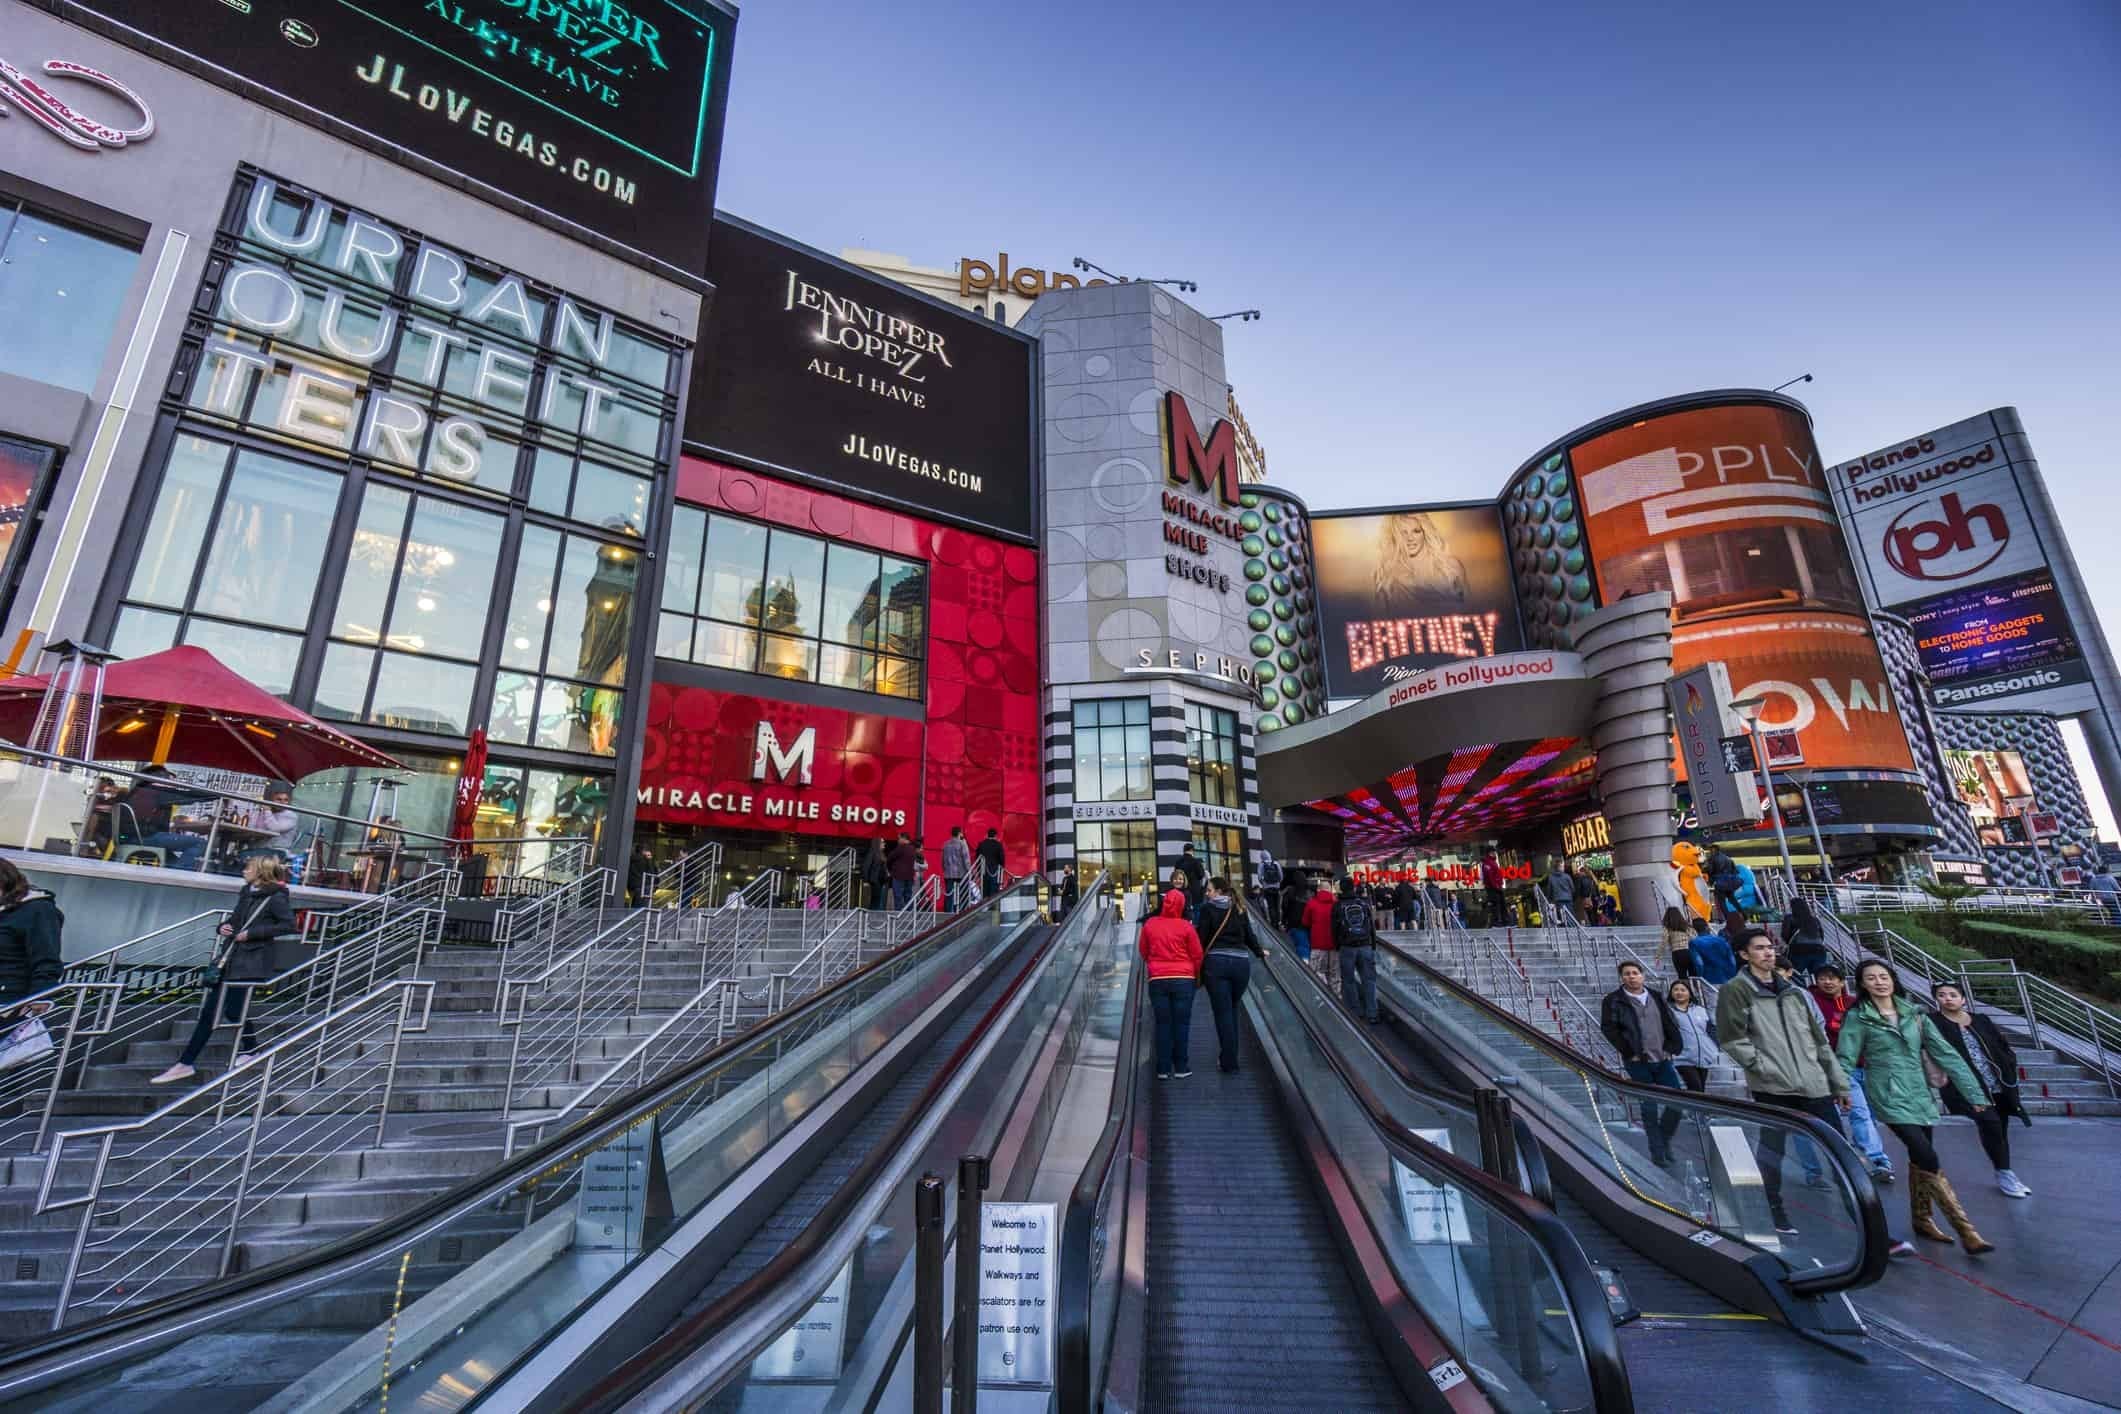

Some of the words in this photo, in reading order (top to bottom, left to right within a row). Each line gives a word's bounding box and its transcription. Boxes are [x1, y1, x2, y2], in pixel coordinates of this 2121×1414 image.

[528, 47, 621, 108] HAVE
[248, 177, 614, 364] URBAN
[784, 270, 952, 368] JENNIFER
[222, 261, 619, 434] OUTFIT
[820, 308, 926, 383] LOPEZ
[808, 357, 851, 383] ALL
[871, 378, 926, 408] HAVE
[202, 338, 487, 482] TERS
[1164, 391, 1240, 506] M
[1848, 437, 1936, 483] planet
[1853, 444, 1995, 504] hollywood
[1162, 491, 1245, 541] MIRACLE
[1164, 521, 1208, 555] MILE
[1166, 553, 1230, 593] SHOPS
[1345, 611, 1499, 673] BRITNEY
[1919, 627, 1987, 649] ELECTRONIC
[1990, 613, 2044, 634] GADGETS
[1952, 637, 1985, 651] HOME
[1987, 627, 2028, 643] GOODS
[1964, 618, 1989, 630] FROM
[1389, 677, 1437, 708] planet
[1445, 658, 1554, 689] hollywood
[1933, 669, 2061, 704] Panasonic
[753, 720, 816, 785] M
[636, 787, 752, 813] MIRACLE
[765, 798, 819, 819] MILE
[831, 803, 906, 826] SHOPS
[1563, 816, 1611, 855] CABAR
[992, 1220, 1026, 1228] Welcome
[985, 1270, 1023, 1280] Walkways
[1025, 1271, 1039, 1280] and
[1034, 1297, 1045, 1306] for
[979, 1325, 1004, 1334] patron
[1007, 1326, 1021, 1334] use
